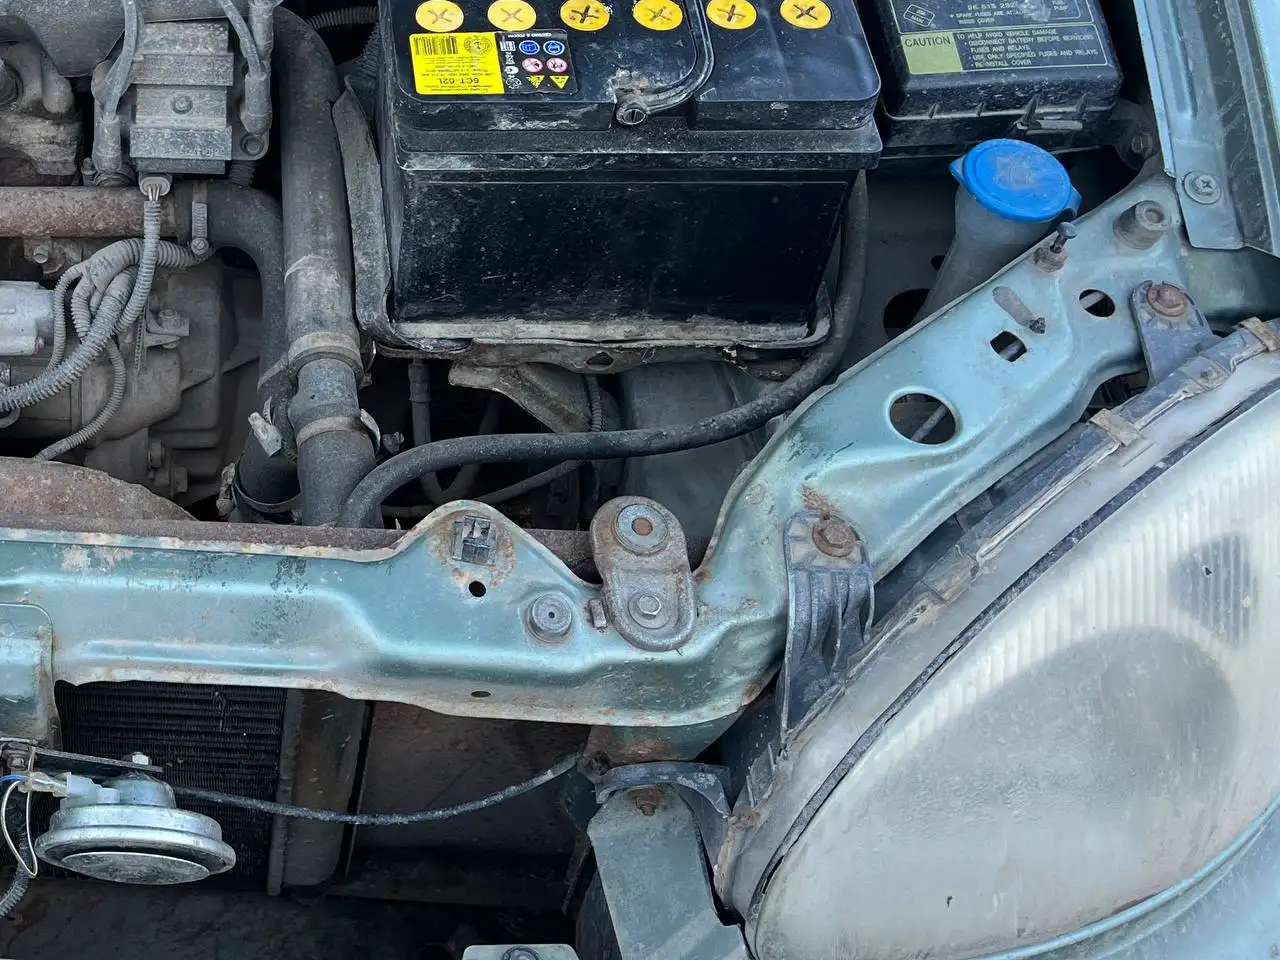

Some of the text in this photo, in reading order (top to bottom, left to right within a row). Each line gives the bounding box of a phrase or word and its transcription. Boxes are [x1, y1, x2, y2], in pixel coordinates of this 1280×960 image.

[904, 36, 951, 48] CAUTION
[1008, 36, 1034, 44] BATTERY
[987, 52, 1004, 60] ONLY
